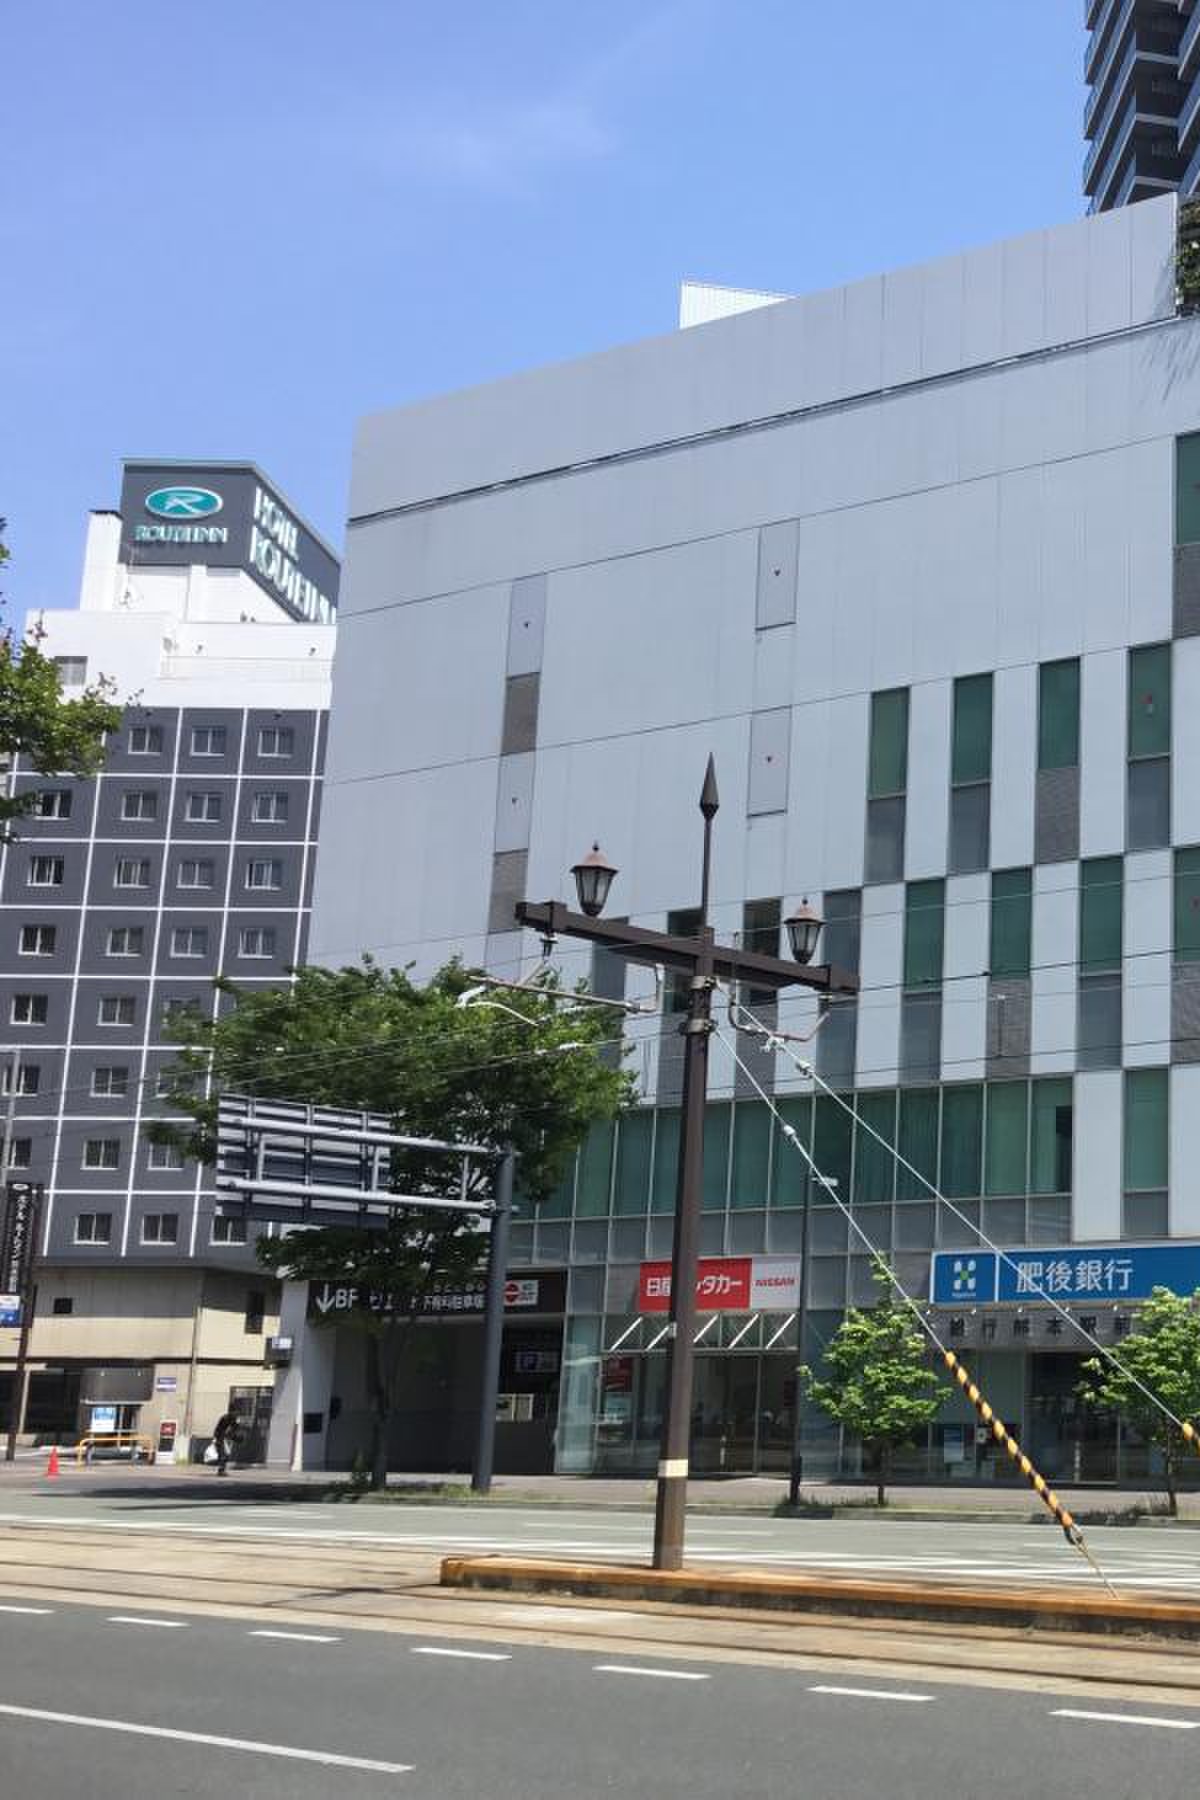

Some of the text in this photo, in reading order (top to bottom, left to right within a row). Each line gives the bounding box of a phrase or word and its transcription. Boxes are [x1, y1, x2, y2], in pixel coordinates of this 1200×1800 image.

[755, 1277, 795, 1287] NISSAN
[1016, 1258, 1133, 1293] 肥後銀行
